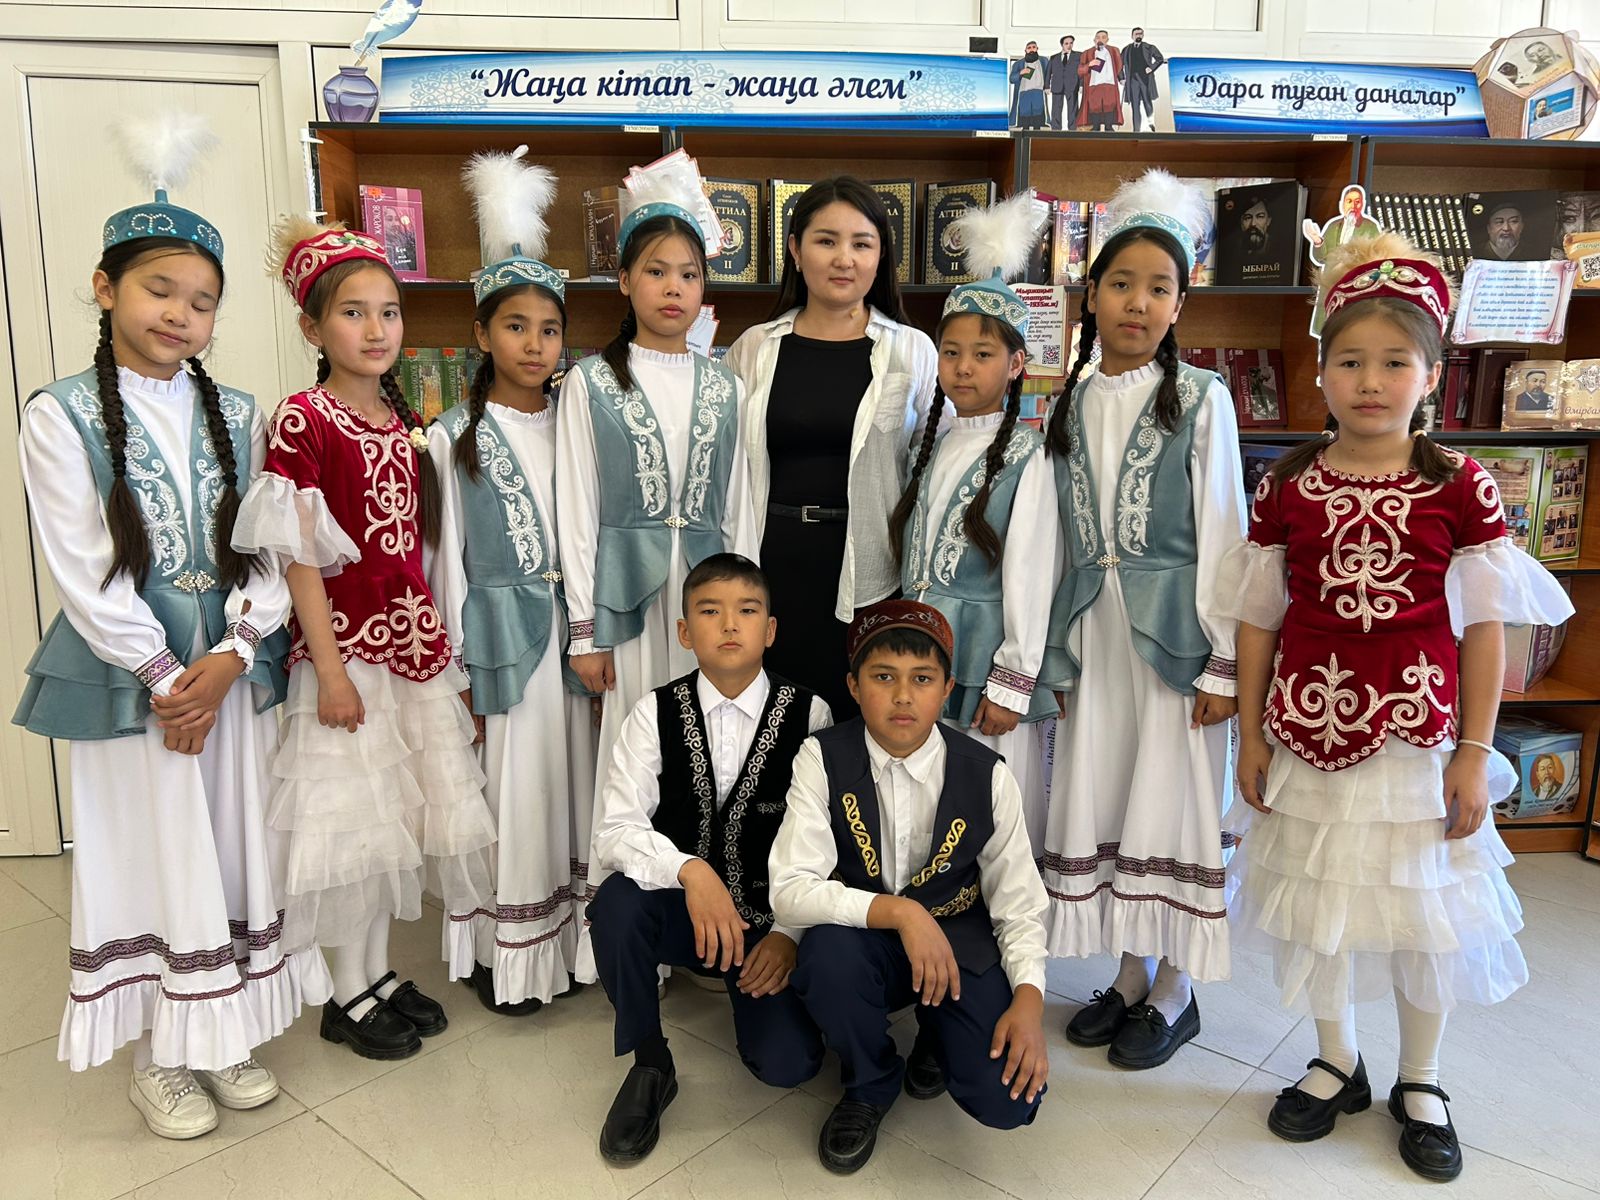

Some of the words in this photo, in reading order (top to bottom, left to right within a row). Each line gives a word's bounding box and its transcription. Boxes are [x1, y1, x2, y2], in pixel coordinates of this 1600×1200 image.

[471, 68, 587, 104] “Жаңа
[596, 69, 693, 97] кітап
[725, 75, 819, 105] жаңа
[828, 70, 923, 99] әлем”
[1184, 74, 1264, 108] “Дара
[1271, 82, 1348, 111] туған
[1355, 86, 1466, 117] даналар”
[713, 207, 746, 216] ТТИЛА
[1242, 262, 1281, 273] ЫБЫРАЙ
